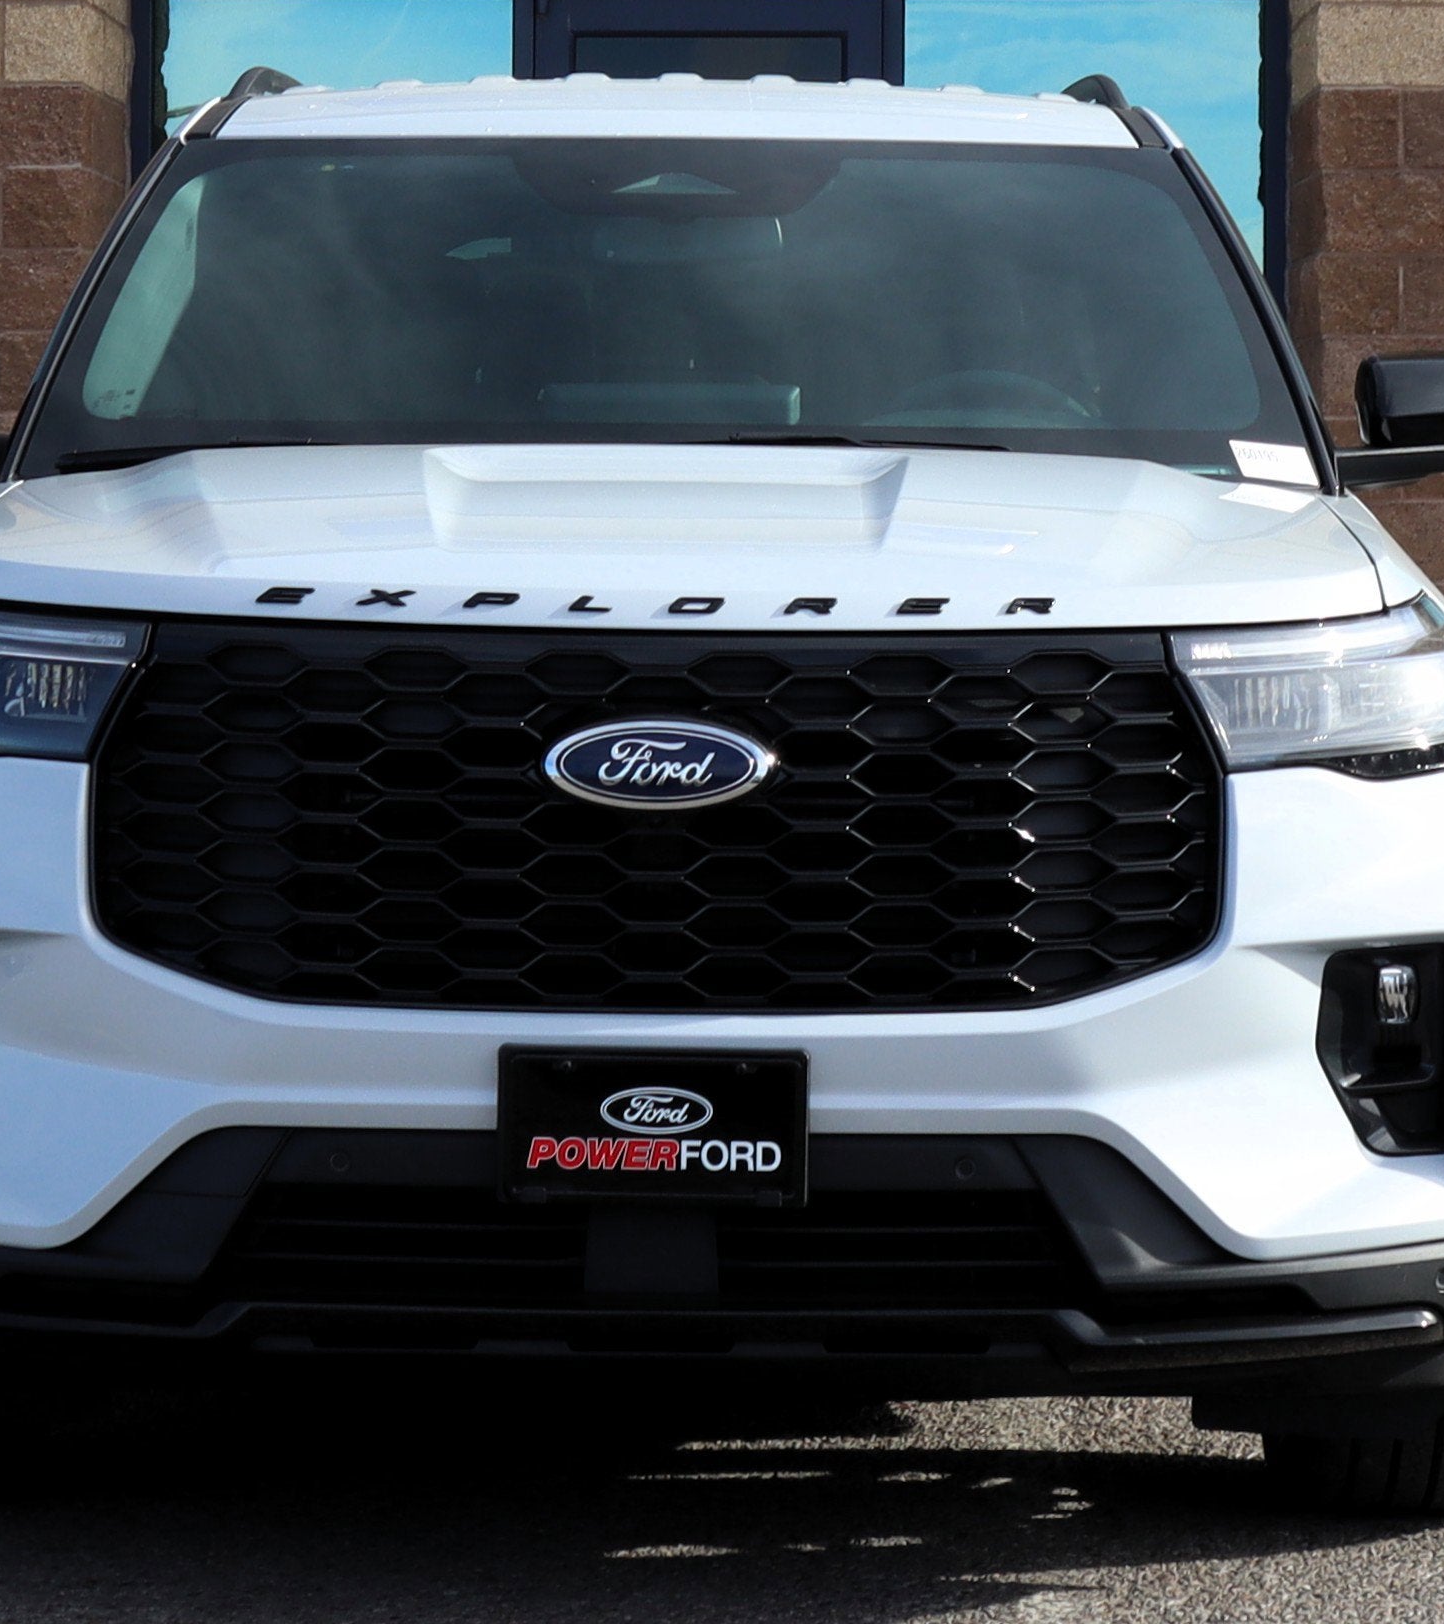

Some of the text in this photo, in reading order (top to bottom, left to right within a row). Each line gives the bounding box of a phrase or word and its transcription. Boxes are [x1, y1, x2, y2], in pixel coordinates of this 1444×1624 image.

[255, 586, 1056, 616] EXPLORER
[598, 738, 716, 787] Ford
[623, 1094, 690, 1124] Ford
